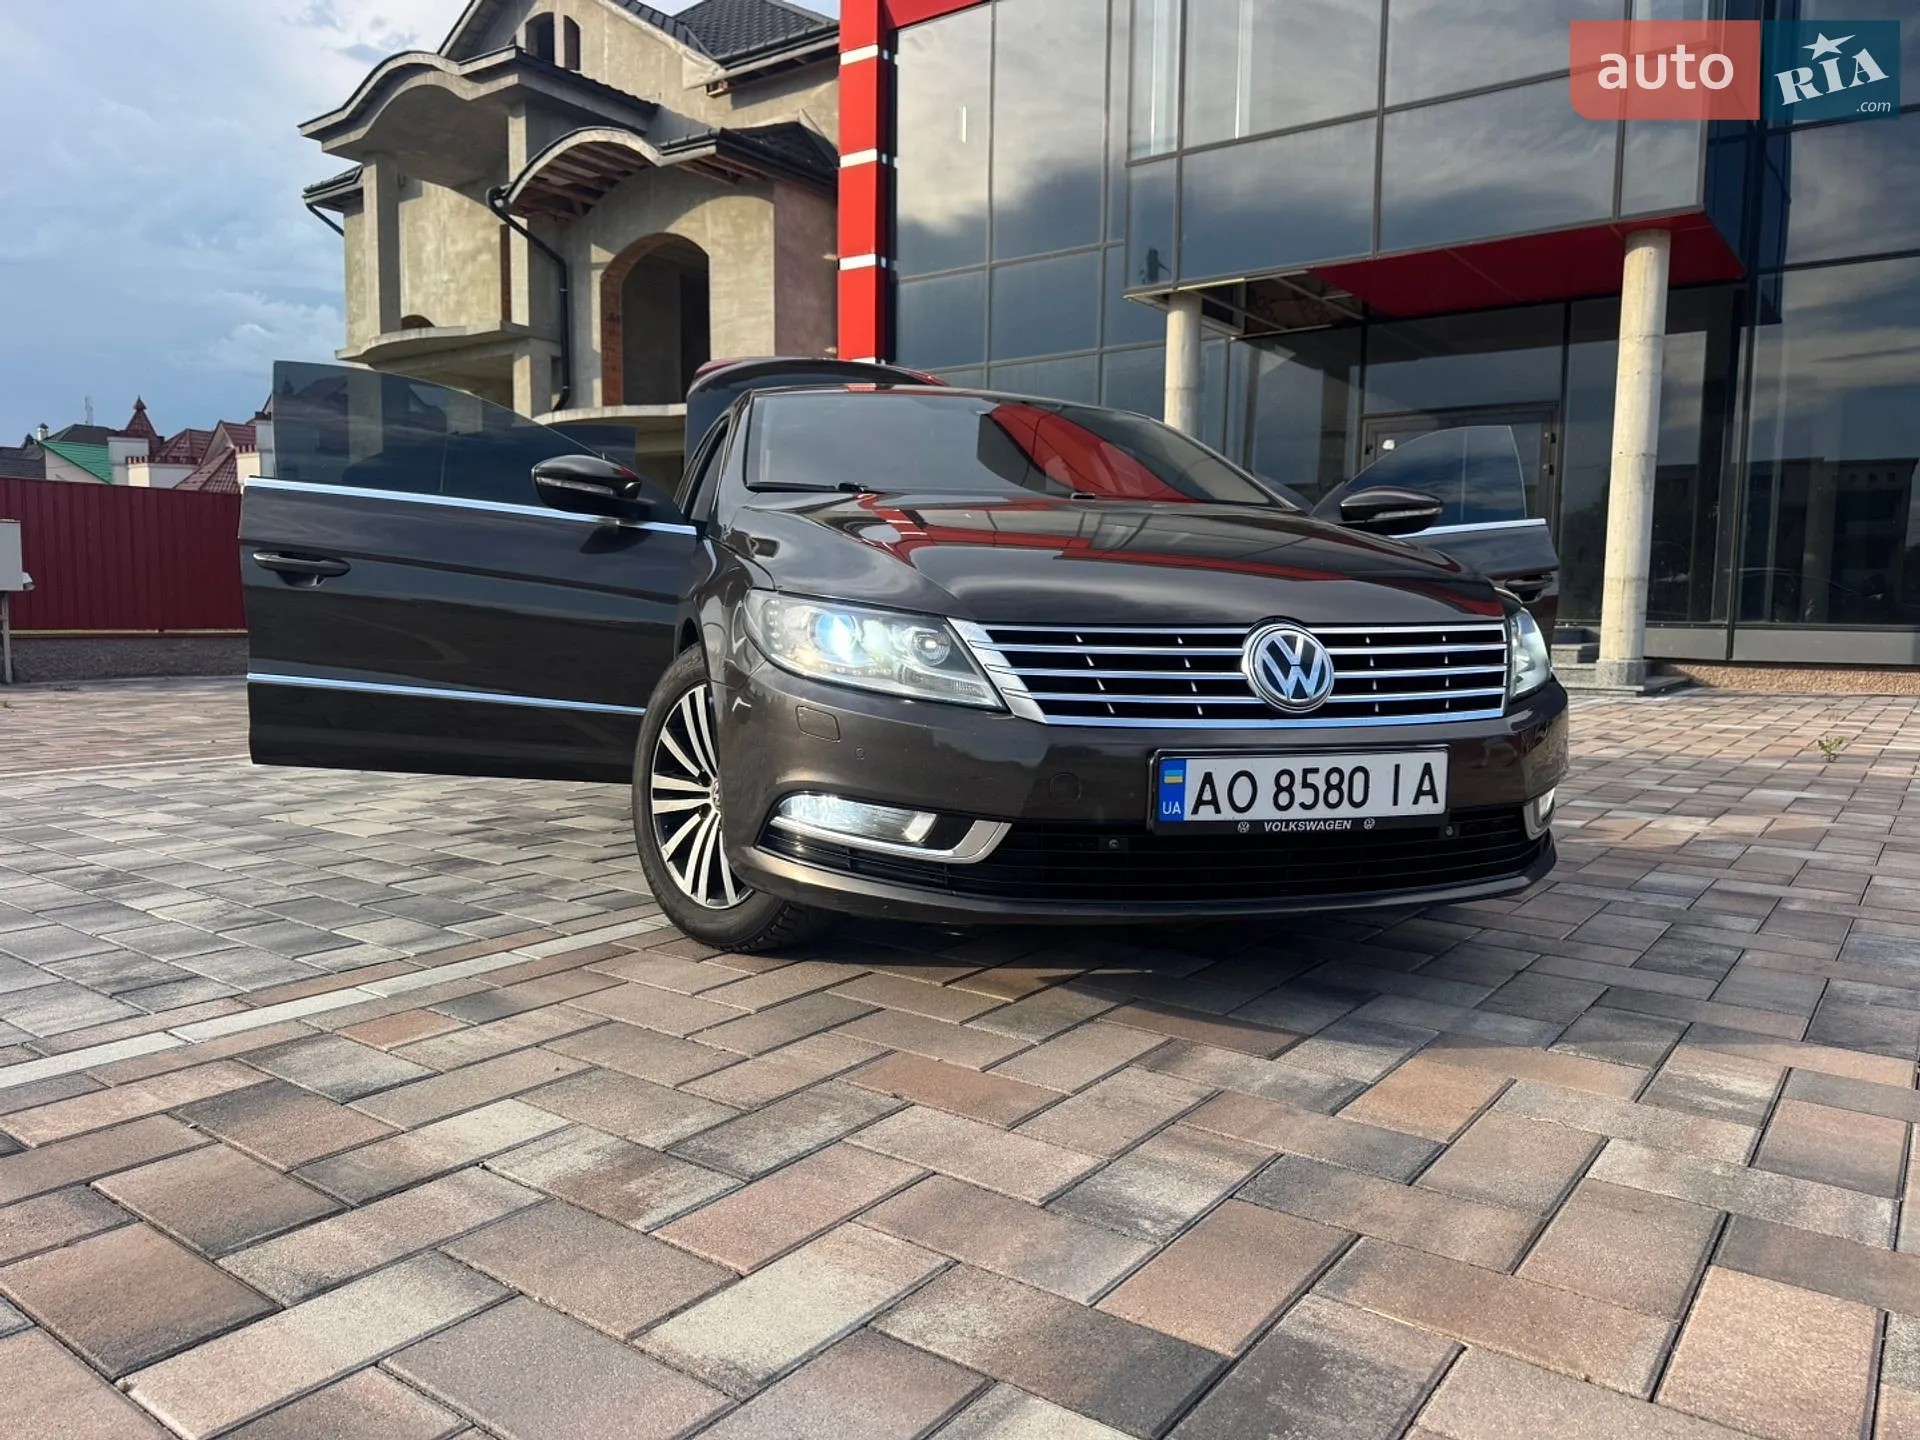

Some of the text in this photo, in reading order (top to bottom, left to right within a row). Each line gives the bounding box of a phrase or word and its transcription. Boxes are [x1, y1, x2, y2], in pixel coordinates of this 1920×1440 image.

[1191, 762, 1439, 816] AO 8580 IA
[1162, 801, 1181, 815] UA
[1264, 820, 1352, 832] VOLKSWAGEN
